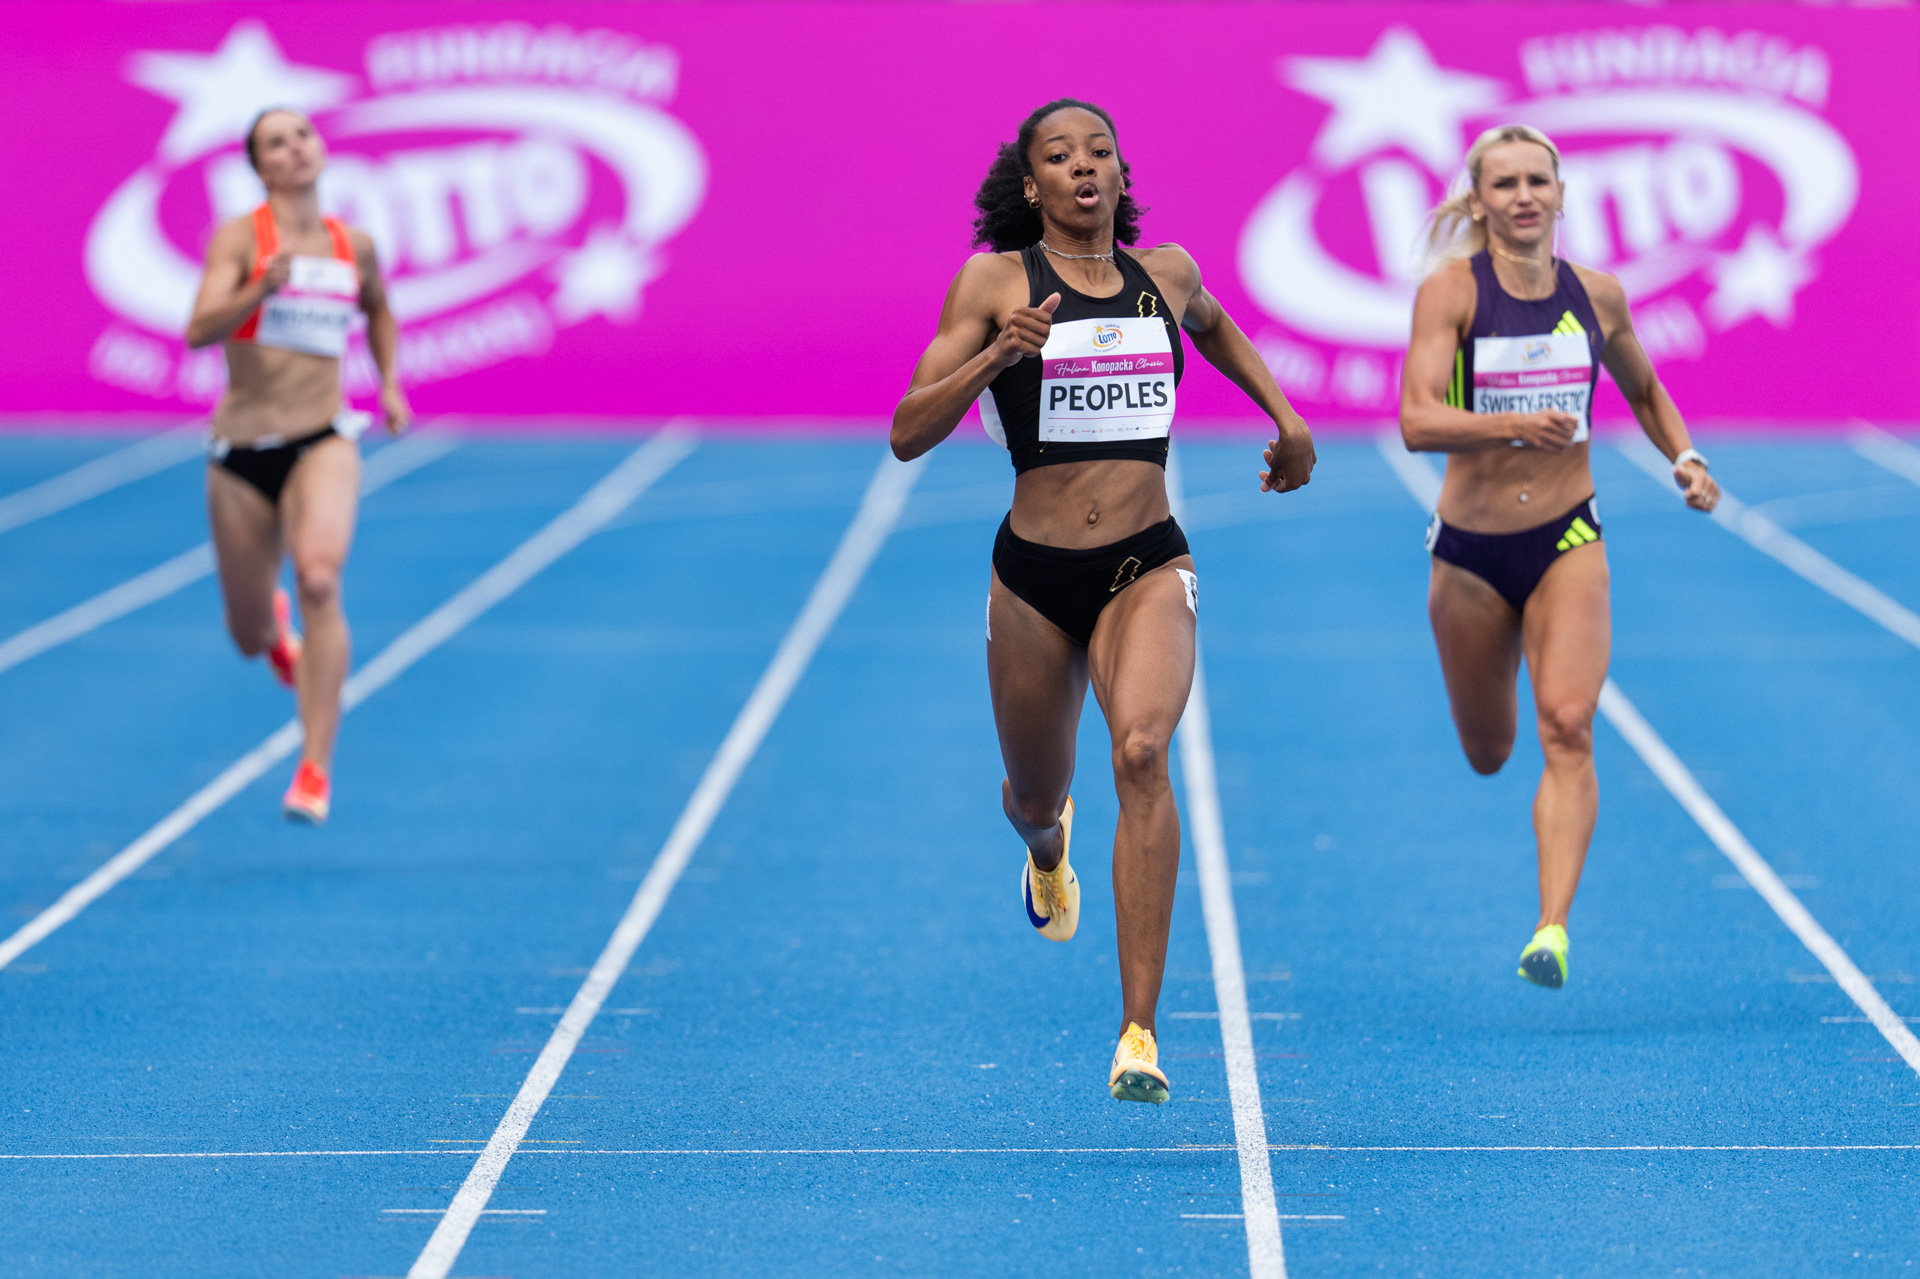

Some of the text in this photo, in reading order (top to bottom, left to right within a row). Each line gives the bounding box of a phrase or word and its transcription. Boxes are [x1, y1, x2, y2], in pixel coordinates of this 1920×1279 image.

[1358, 136, 1741, 284] LTTO
[1098, 332, 1117, 344] LOTTO
[1054, 358, 1164, 376] Halina Konopacka Classic
[1050, 381, 1168, 411] PEOPLES
